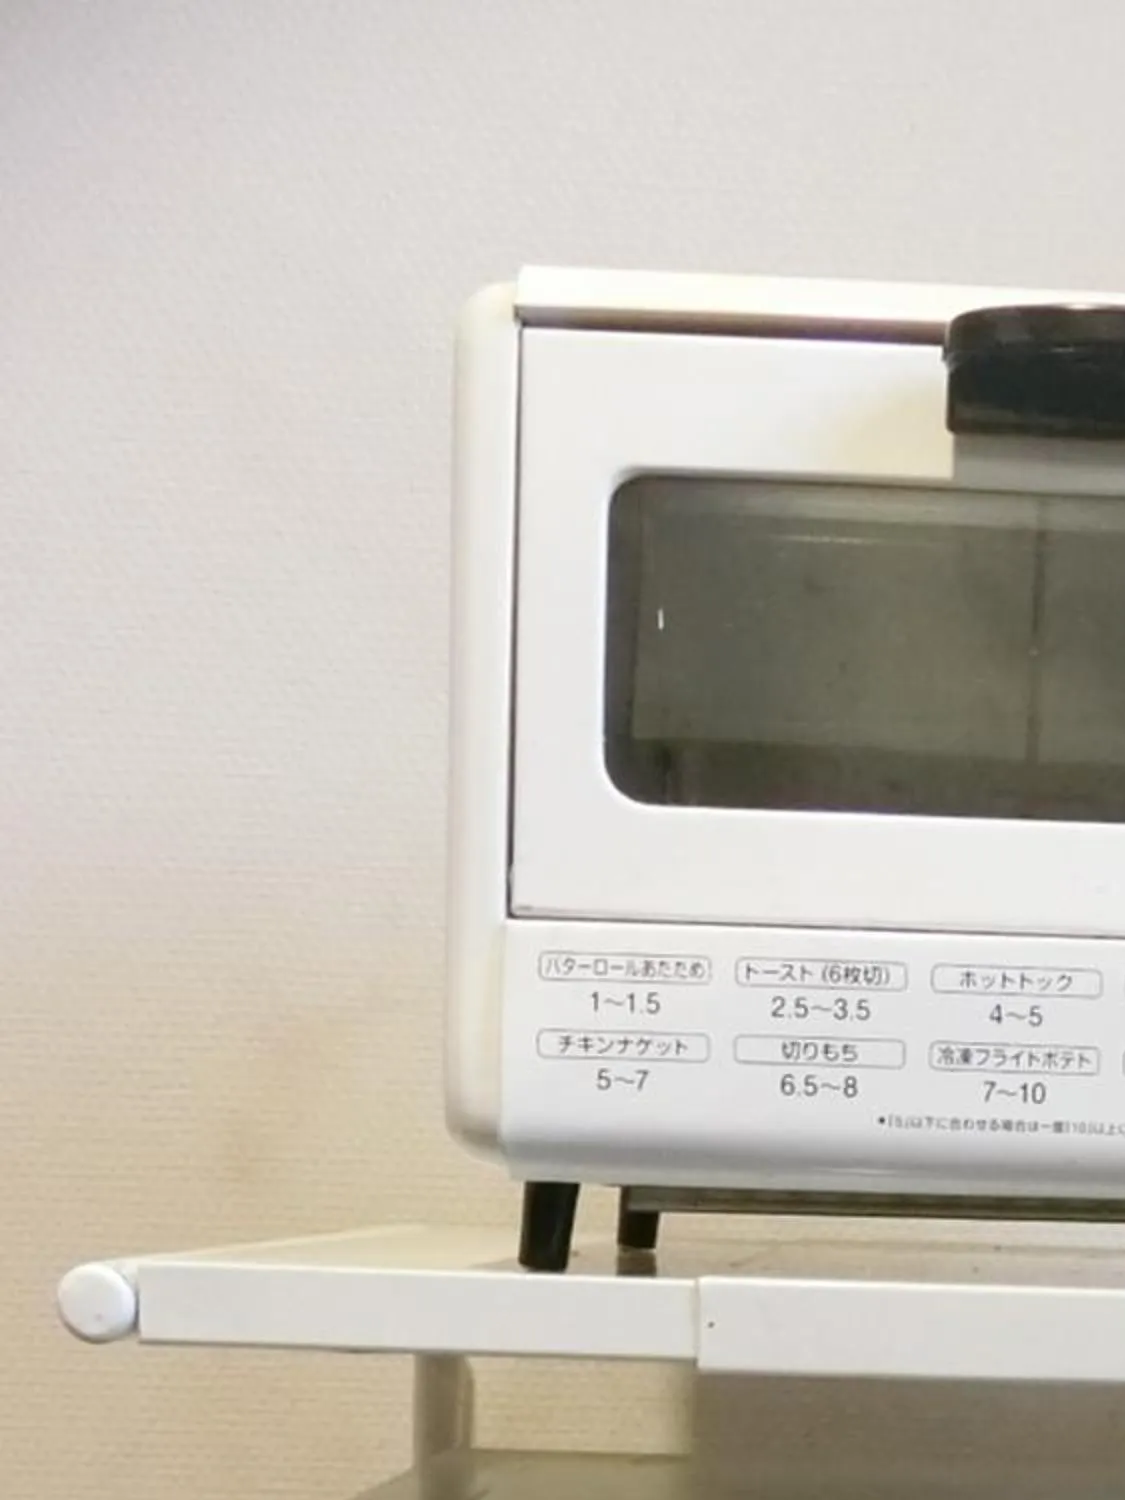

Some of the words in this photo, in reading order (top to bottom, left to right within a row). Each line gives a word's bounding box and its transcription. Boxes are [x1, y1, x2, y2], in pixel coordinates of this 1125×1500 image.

[545, 957, 706, 981] バターロールあたため
[781, 1041, 859, 1063] 切りもち
